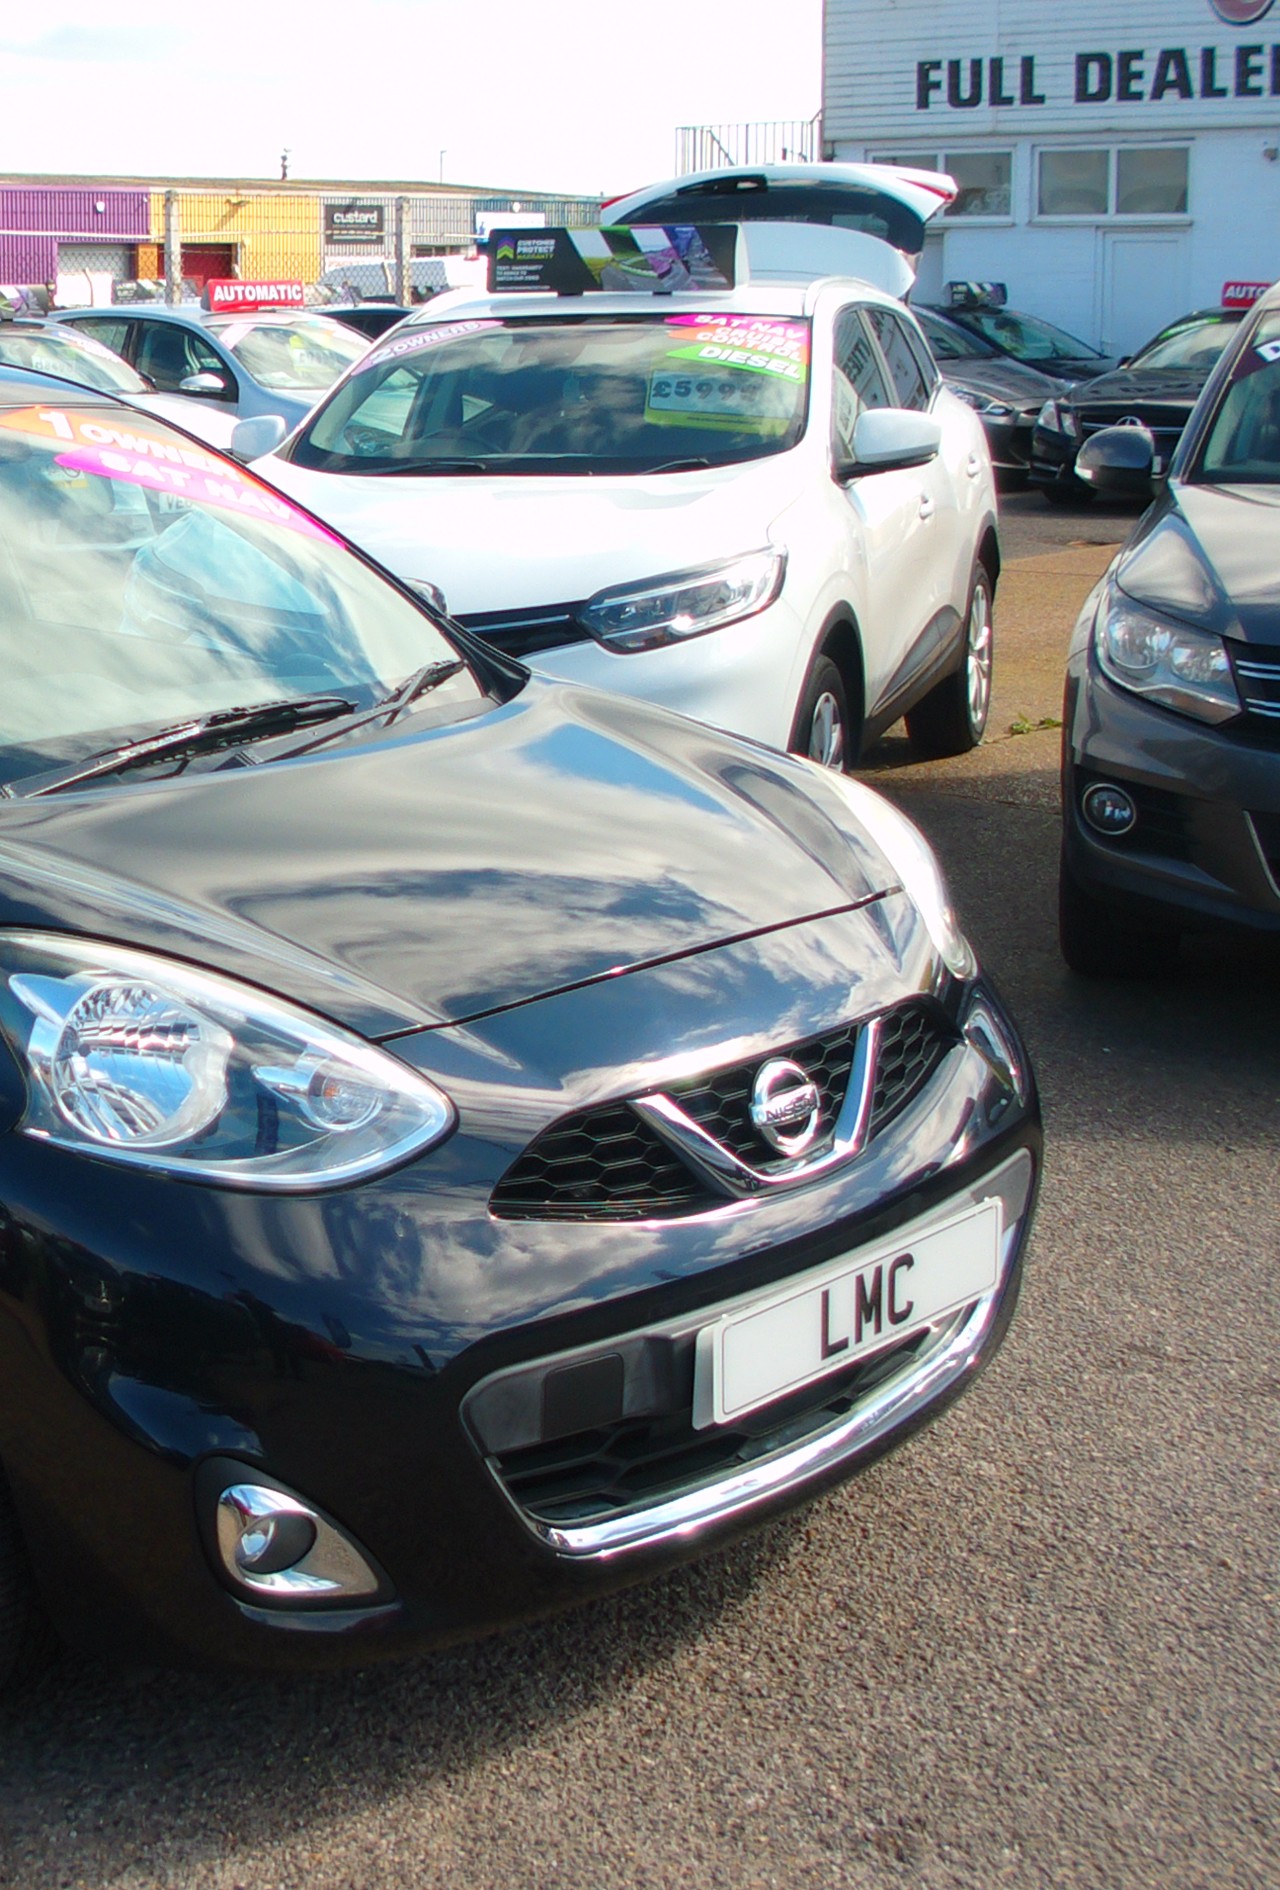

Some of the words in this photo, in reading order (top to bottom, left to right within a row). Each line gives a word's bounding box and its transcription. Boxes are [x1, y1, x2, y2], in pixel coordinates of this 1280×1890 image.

[916, 55, 1046, 110] FULL
[333, 210, 378, 224] custard
[516, 246, 555, 255] PROTECT
[213, 285, 303, 302] AUTOMATIC
[369, 348, 395, 365] 2
[392, 322, 481, 353] OWNERS
[694, 314, 748, 328] SAT
[750, 322, 805, 340] NAV
[716, 326, 802, 348] CRUISE
[696, 331, 802, 363] CONTROL
[697, 345, 802, 380] DIESEL
[39, 410, 75, 440] 1
[79, 422, 243, 483] OWNER
[98, 450, 193, 489] SAT
[203, 477, 293, 521] NAV
[821, 1251, 915, 1361] LMC
